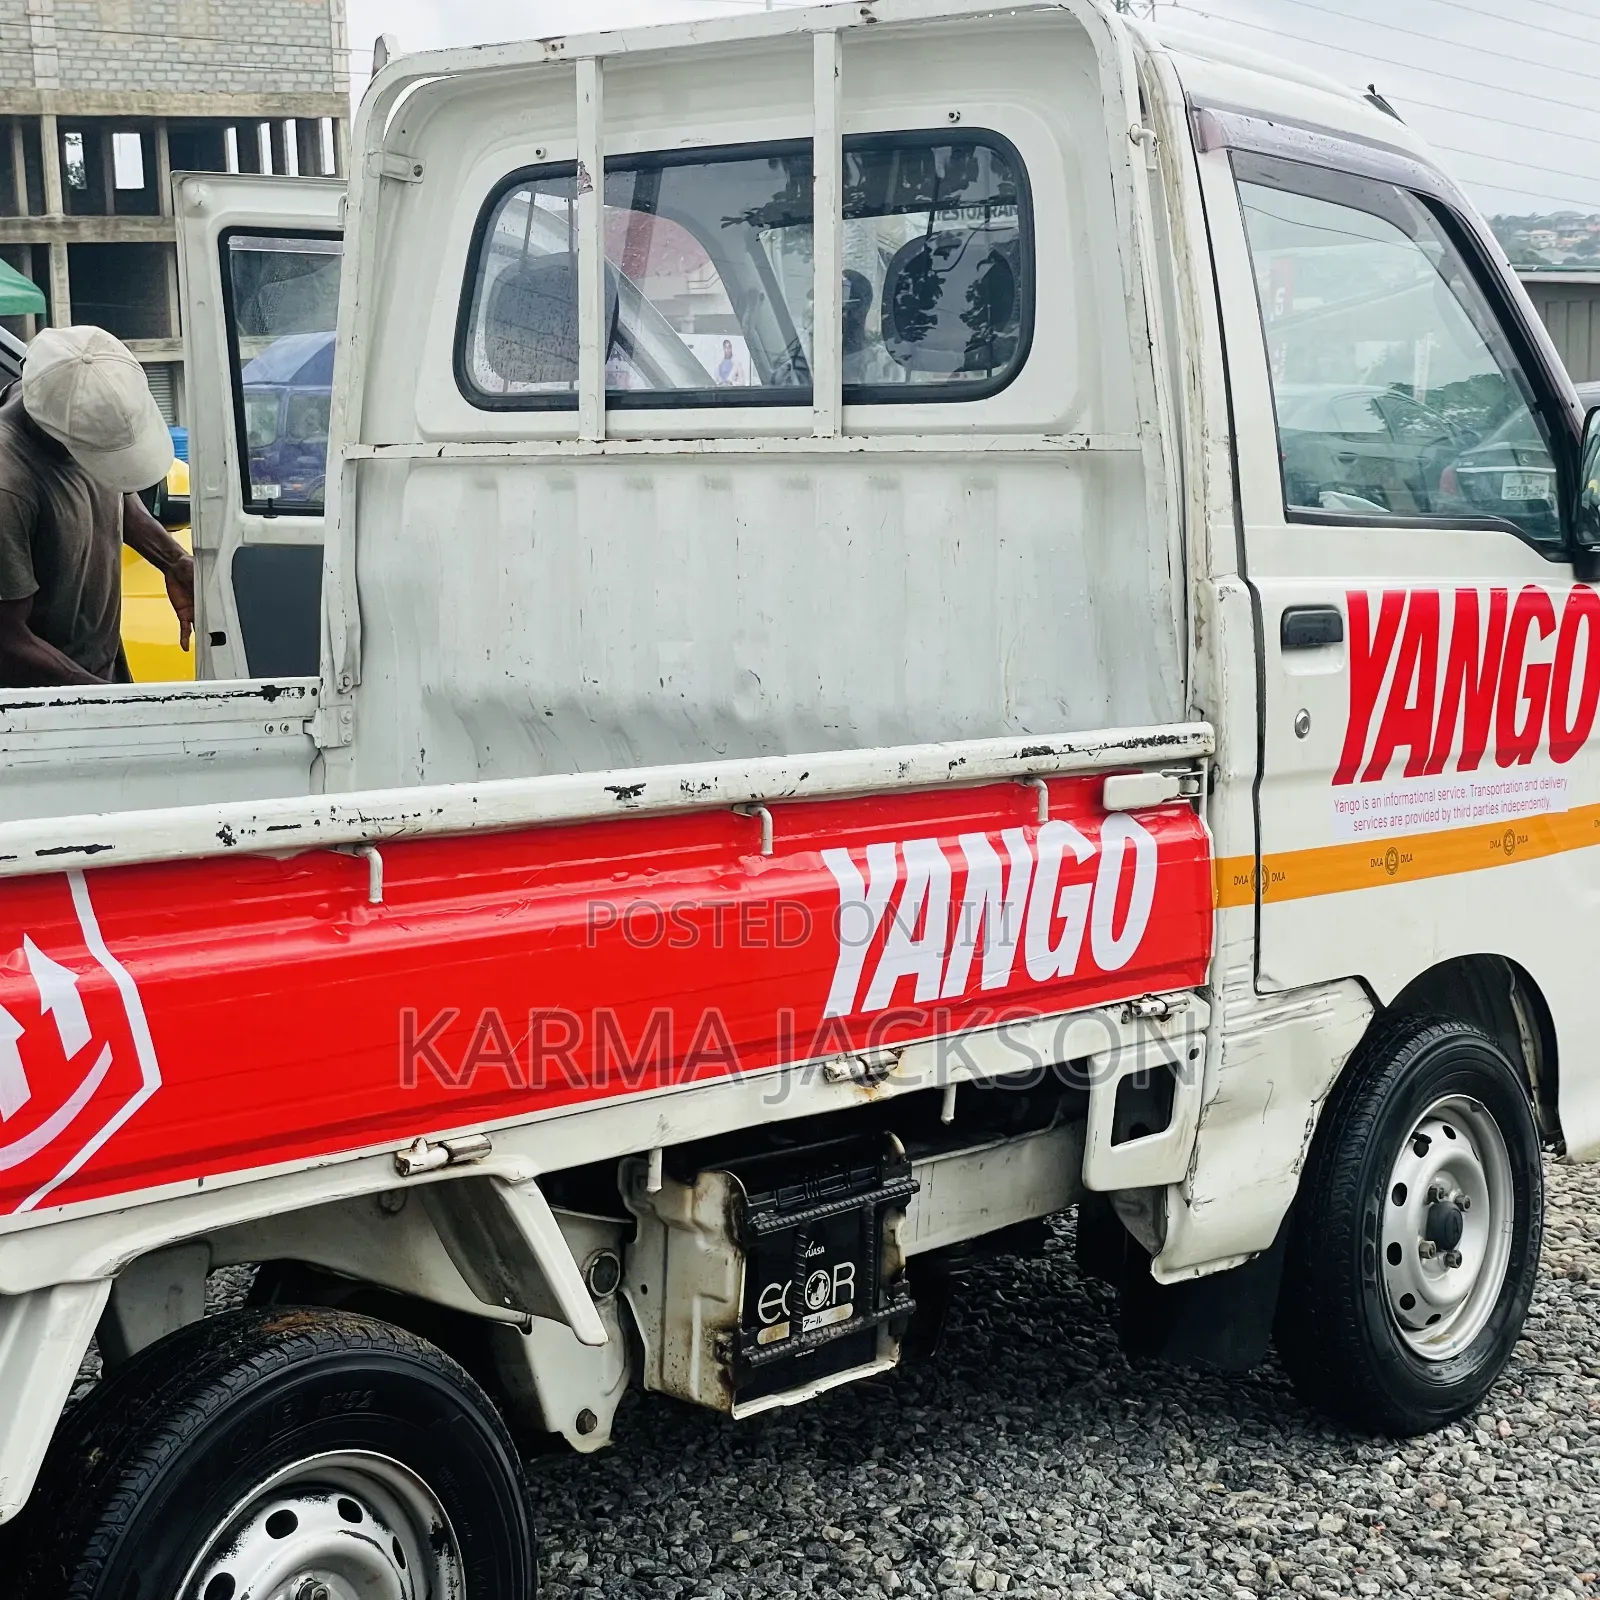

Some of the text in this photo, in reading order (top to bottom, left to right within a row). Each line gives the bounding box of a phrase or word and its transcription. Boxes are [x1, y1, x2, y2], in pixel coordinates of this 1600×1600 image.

[1332, 584, 1600, 786] YANGO
[1334, 776, 1568, 815] Yango is an informational service. Transportation and delivery
[1354, 797, 1551, 832] services are provided by third parties independently.
[1490, 835, 1528, 849] DVLA DVLA
[1370, 854, 1413, 867] DVLA DVLA
[1234, 871, 1286, 886] DVLA DVLA
[821, 812, 1158, 1018] YANGO
